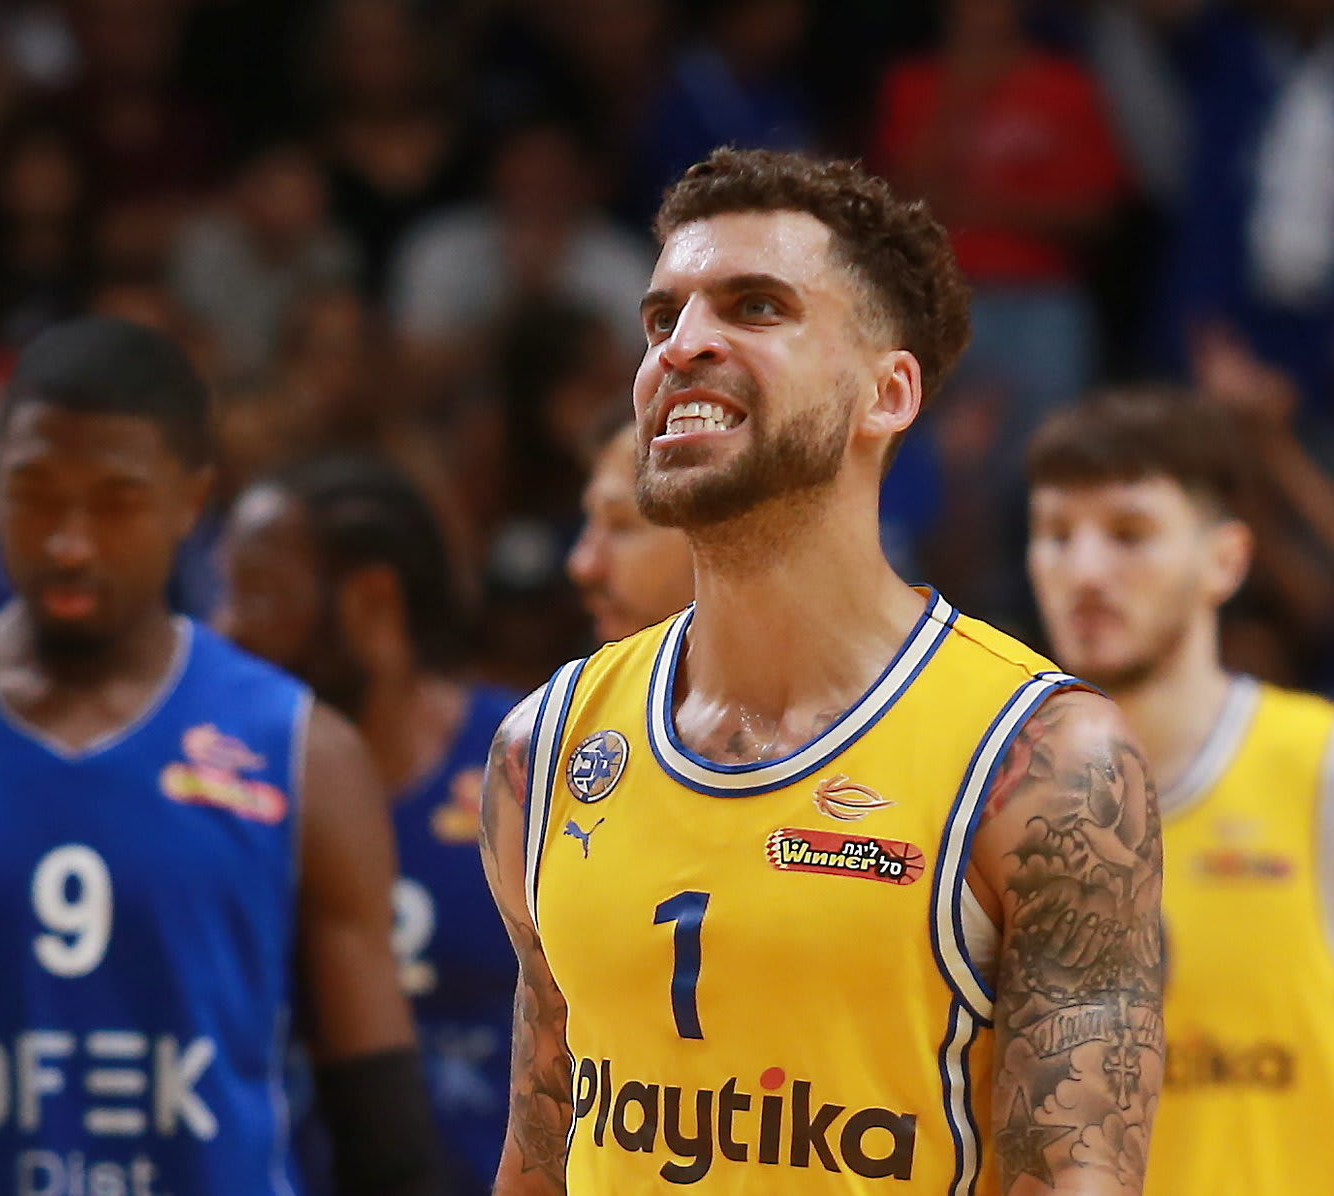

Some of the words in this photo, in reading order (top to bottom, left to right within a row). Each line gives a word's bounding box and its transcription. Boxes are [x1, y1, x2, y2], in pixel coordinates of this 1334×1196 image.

[30, 843, 113, 979] 9
[781, 840, 876, 871] Winner
[879, 856, 902, 875] סל
[842, 841, 879, 857] ליגת
[653, 890, 710, 1040] 1
[575, 1057, 917, 1185] Playtika
